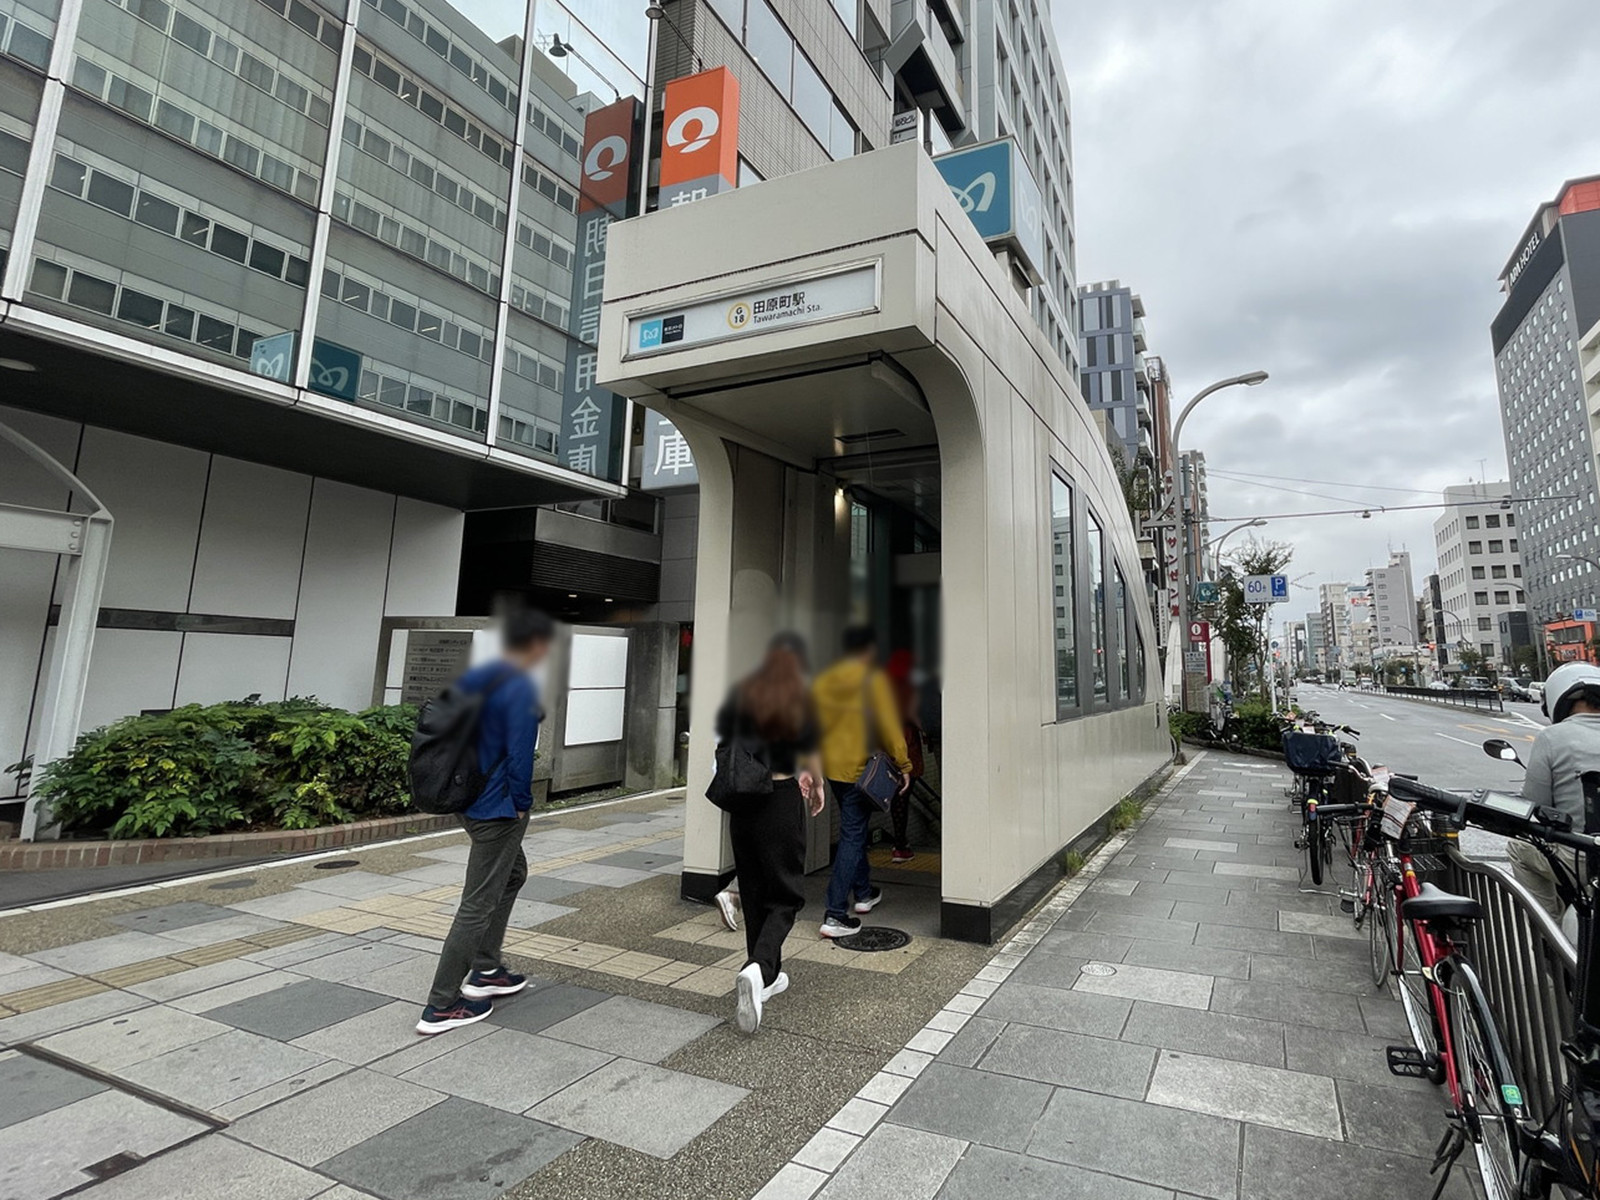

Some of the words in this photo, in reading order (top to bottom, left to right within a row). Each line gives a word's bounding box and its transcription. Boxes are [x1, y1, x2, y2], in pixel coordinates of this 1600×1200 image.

[1519, 231, 1541, 269] HOTEL
[736, 307, 743, 315] G
[753, 291, 805, 314] 田原町駅
[753, 305, 805, 324] Tawaramachi
[806, 303, 823, 314] Sta.
[734, 314, 745, 323] 18
[653, 417, 694, 476] 庫
